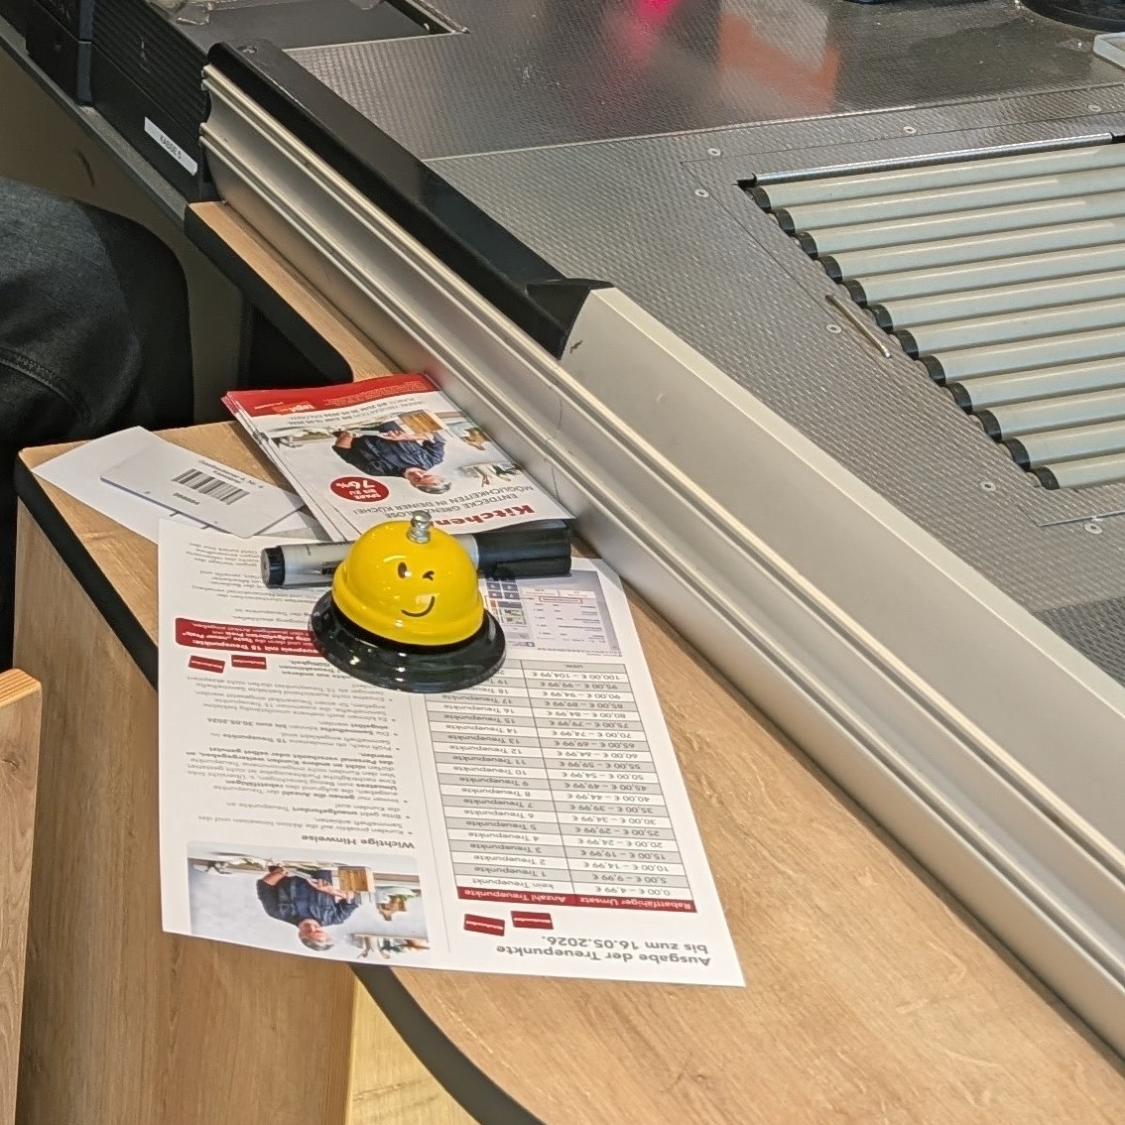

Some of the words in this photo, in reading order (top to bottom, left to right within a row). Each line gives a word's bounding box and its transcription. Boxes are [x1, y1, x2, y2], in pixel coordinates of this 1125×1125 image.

[336, 478, 375, 490] 76%
[463, 493, 518, 510] ENTDECKE
[430, 504, 535, 527] Kitchen
[464, 807, 524, 818] Treuepunkte
[466, 819, 526, 829] Treuepunkte
[302, 834, 355, 845] Hinweise
[468, 830, 529, 841] Treuepunkte
[361, 837, 413, 849] Wichtige
[470, 841, 531, 852] Treuepunkte
[472, 853, 534, 864] Treuepunkte
[588, 849, 617, 857] 19,99
[637, 851, 666, 860] 15,00
[591, 860, 620, 869] 14,99
[640, 863, 670, 872] 10,00
[474, 865, 536, 876] Treuepunkte
[472, 877, 528, 888] Treuepunkt
[600, 873, 623, 881] 9,99
[644, 875, 667, 884] 5,00
[464, 887, 526, 900] Treuepunkte
[603, 885, 627, 893] 4,99
[647, 887, 670, 896] 0,00
[531, 893, 565, 902] Anzahl
[579, 895, 618, 905] Umsatz
[620, 897, 690, 909] Rabattfähiger
[541, 935, 638, 950] 16.05.2026.
[645, 941, 678, 951] zum
[681, 942, 708, 954] bis
[496, 943, 598, 960] Treuepunkte
[604, 950, 633, 962] der
[638, 951, 710, 966] Ausgabe
